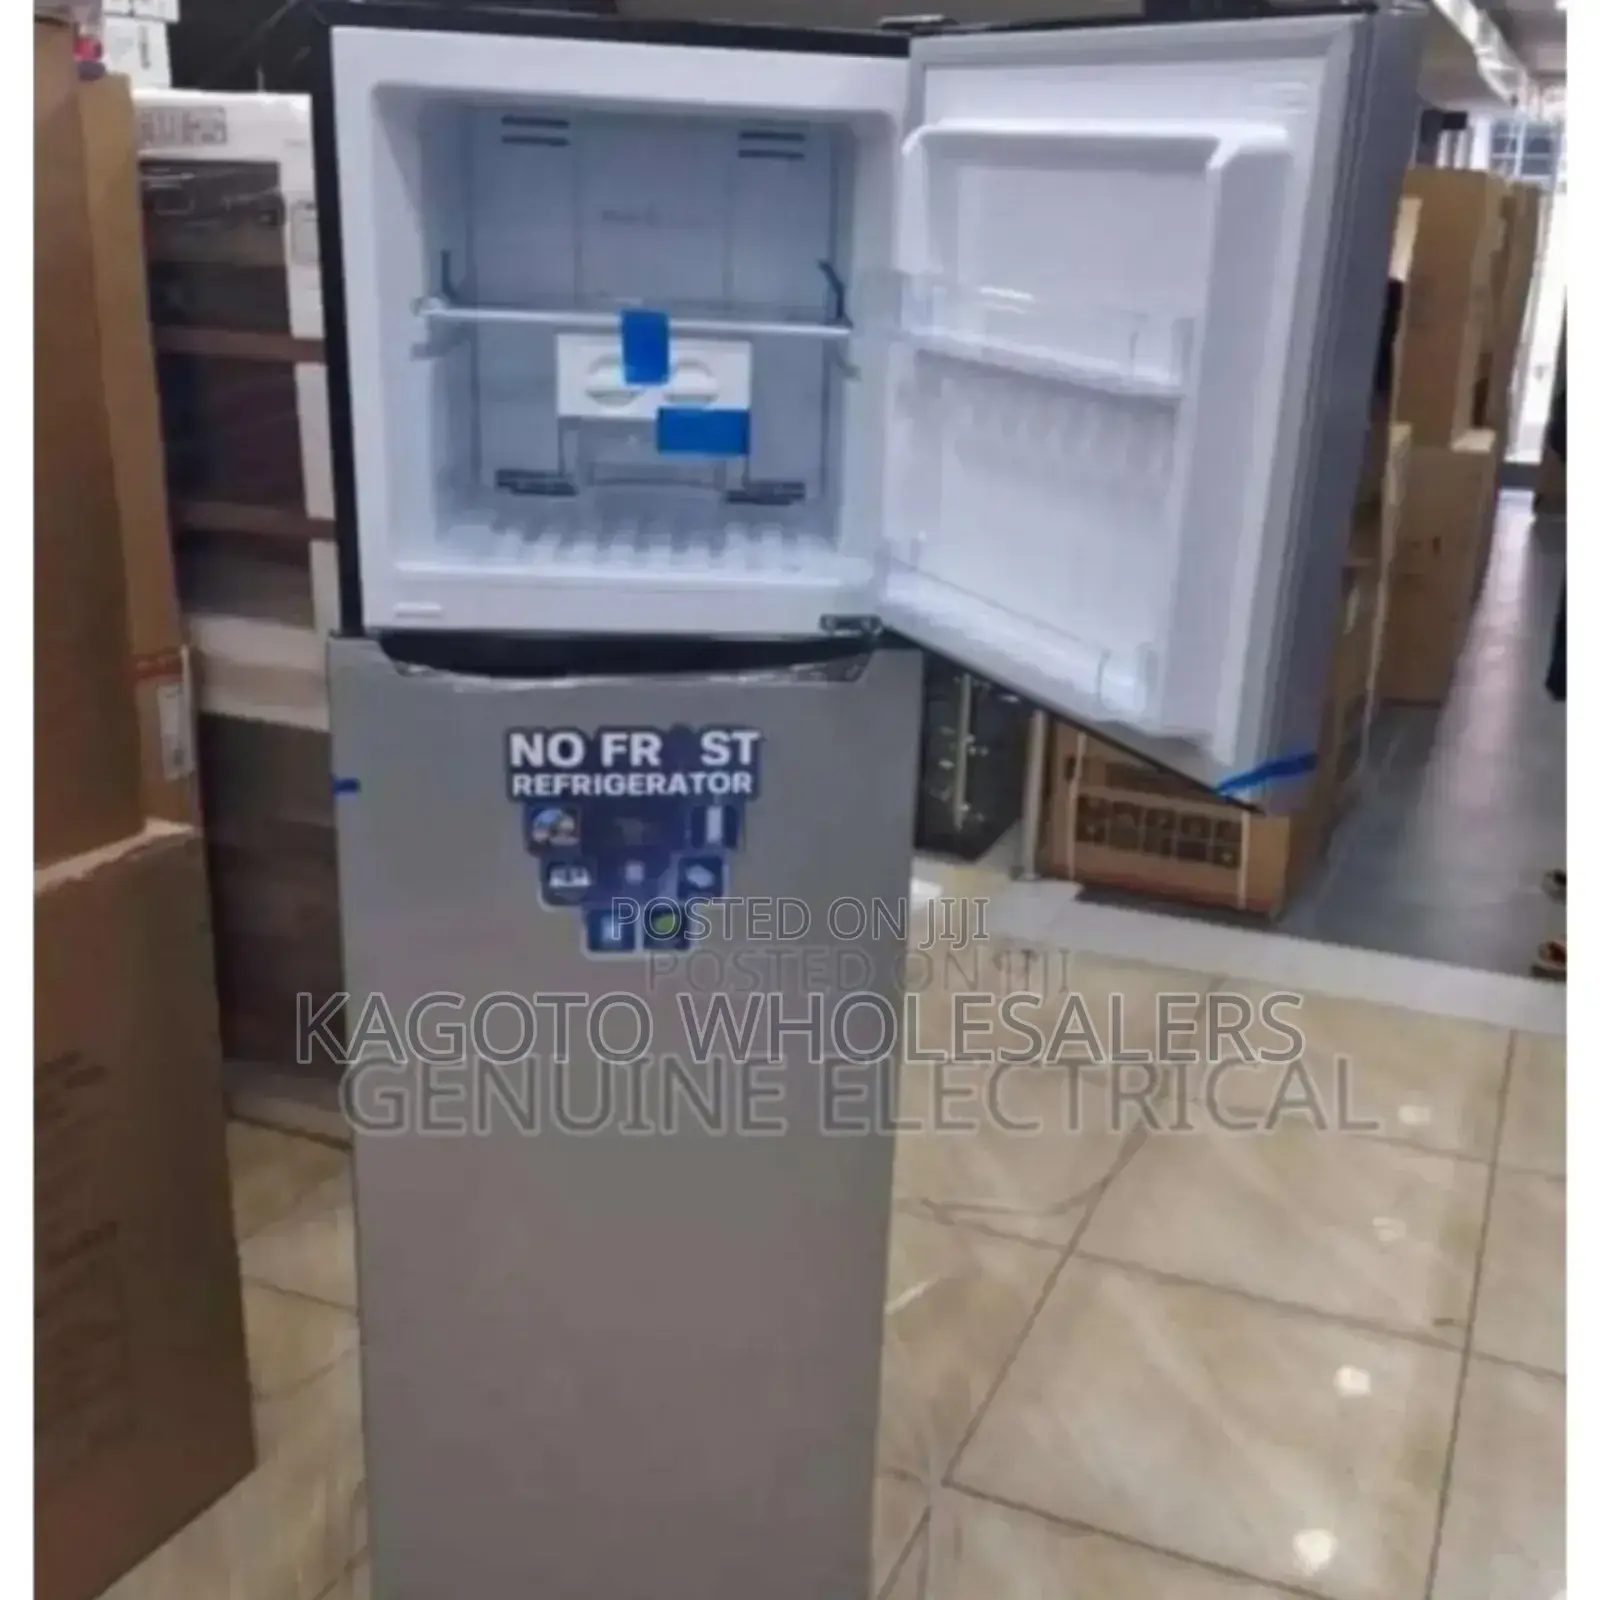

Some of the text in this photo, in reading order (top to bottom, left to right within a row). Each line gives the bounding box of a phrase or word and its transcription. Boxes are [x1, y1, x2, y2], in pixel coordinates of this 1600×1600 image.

[509, 730, 760, 768] NO FRST
[512, 771, 752, 796] REFRIGERATOR
